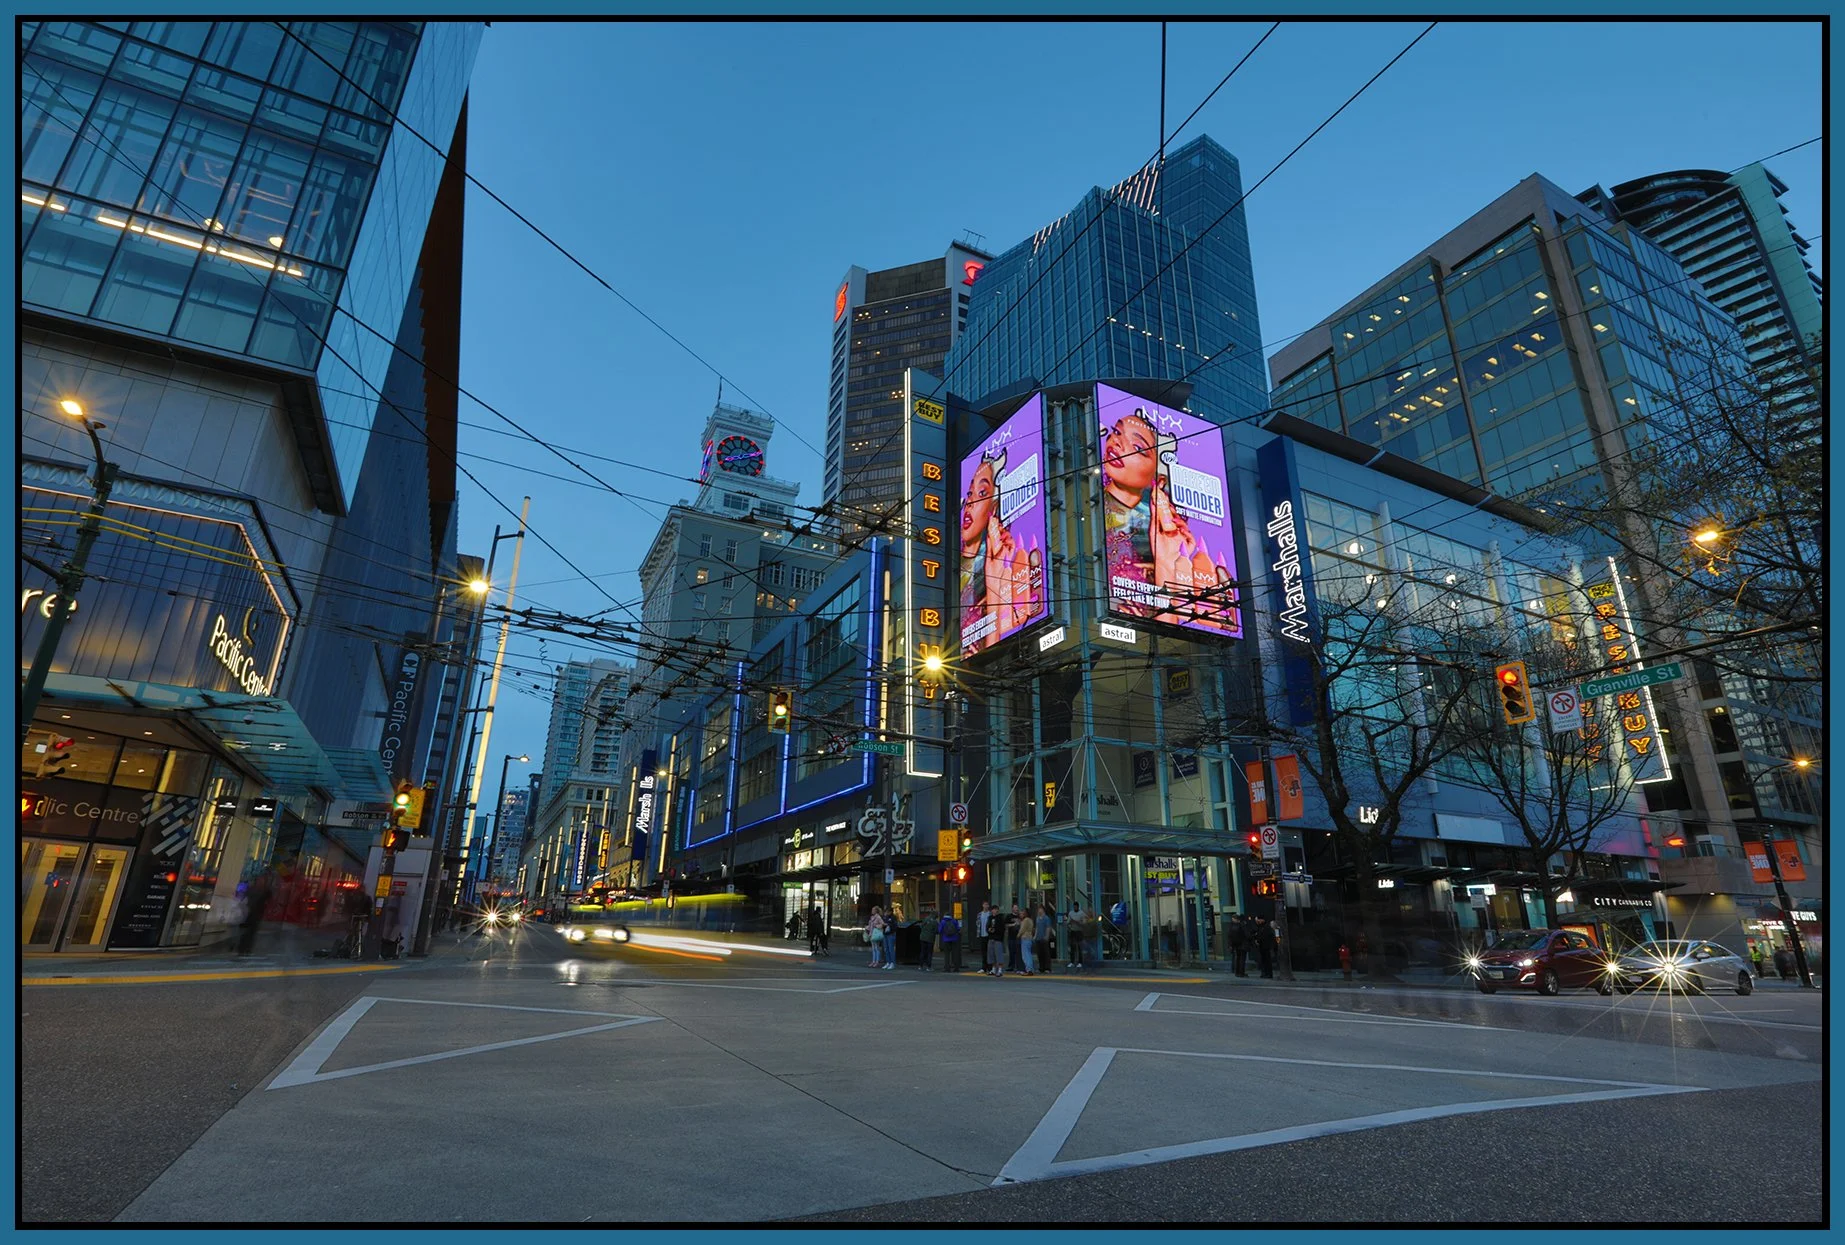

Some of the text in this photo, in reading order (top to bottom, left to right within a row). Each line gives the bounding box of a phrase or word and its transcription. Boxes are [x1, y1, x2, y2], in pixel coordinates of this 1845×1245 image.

[919, 400, 944, 414] BEST
[919, 408, 941, 420] BUY
[1142, 405, 1183, 432] NYX
[985, 425, 1012, 459] NYX
[1002, 476, 1037, 516] WONDER
[1174, 484, 1222, 516] WONDER
[922, 461, 942, 579] BEST
[1193, 570, 1215, 583] NYX
[1267, 500, 1311, 643] Marshalls
[1112, 575, 1136, 590] COVERS
[1042, 630, 1063, 648] astral
[1104, 627, 1134, 641] astral
[209, 614, 244, 678] Pacific
[1586, 666, 1676, 696] Granville St
[389, 680, 415, 733] Pacific
[1617, 692, 1651, 754] BUY
[890, 745, 899, 754] St
[73, 801, 139, 824] Centre
[1360, 806, 1379, 825] Lid
[1145, 857, 1177, 870] arshalls
[1378, 879, 1395, 889] Lids
[1594, 897, 1617, 906] CITY
[1800, 911, 1817, 921] GUYS
